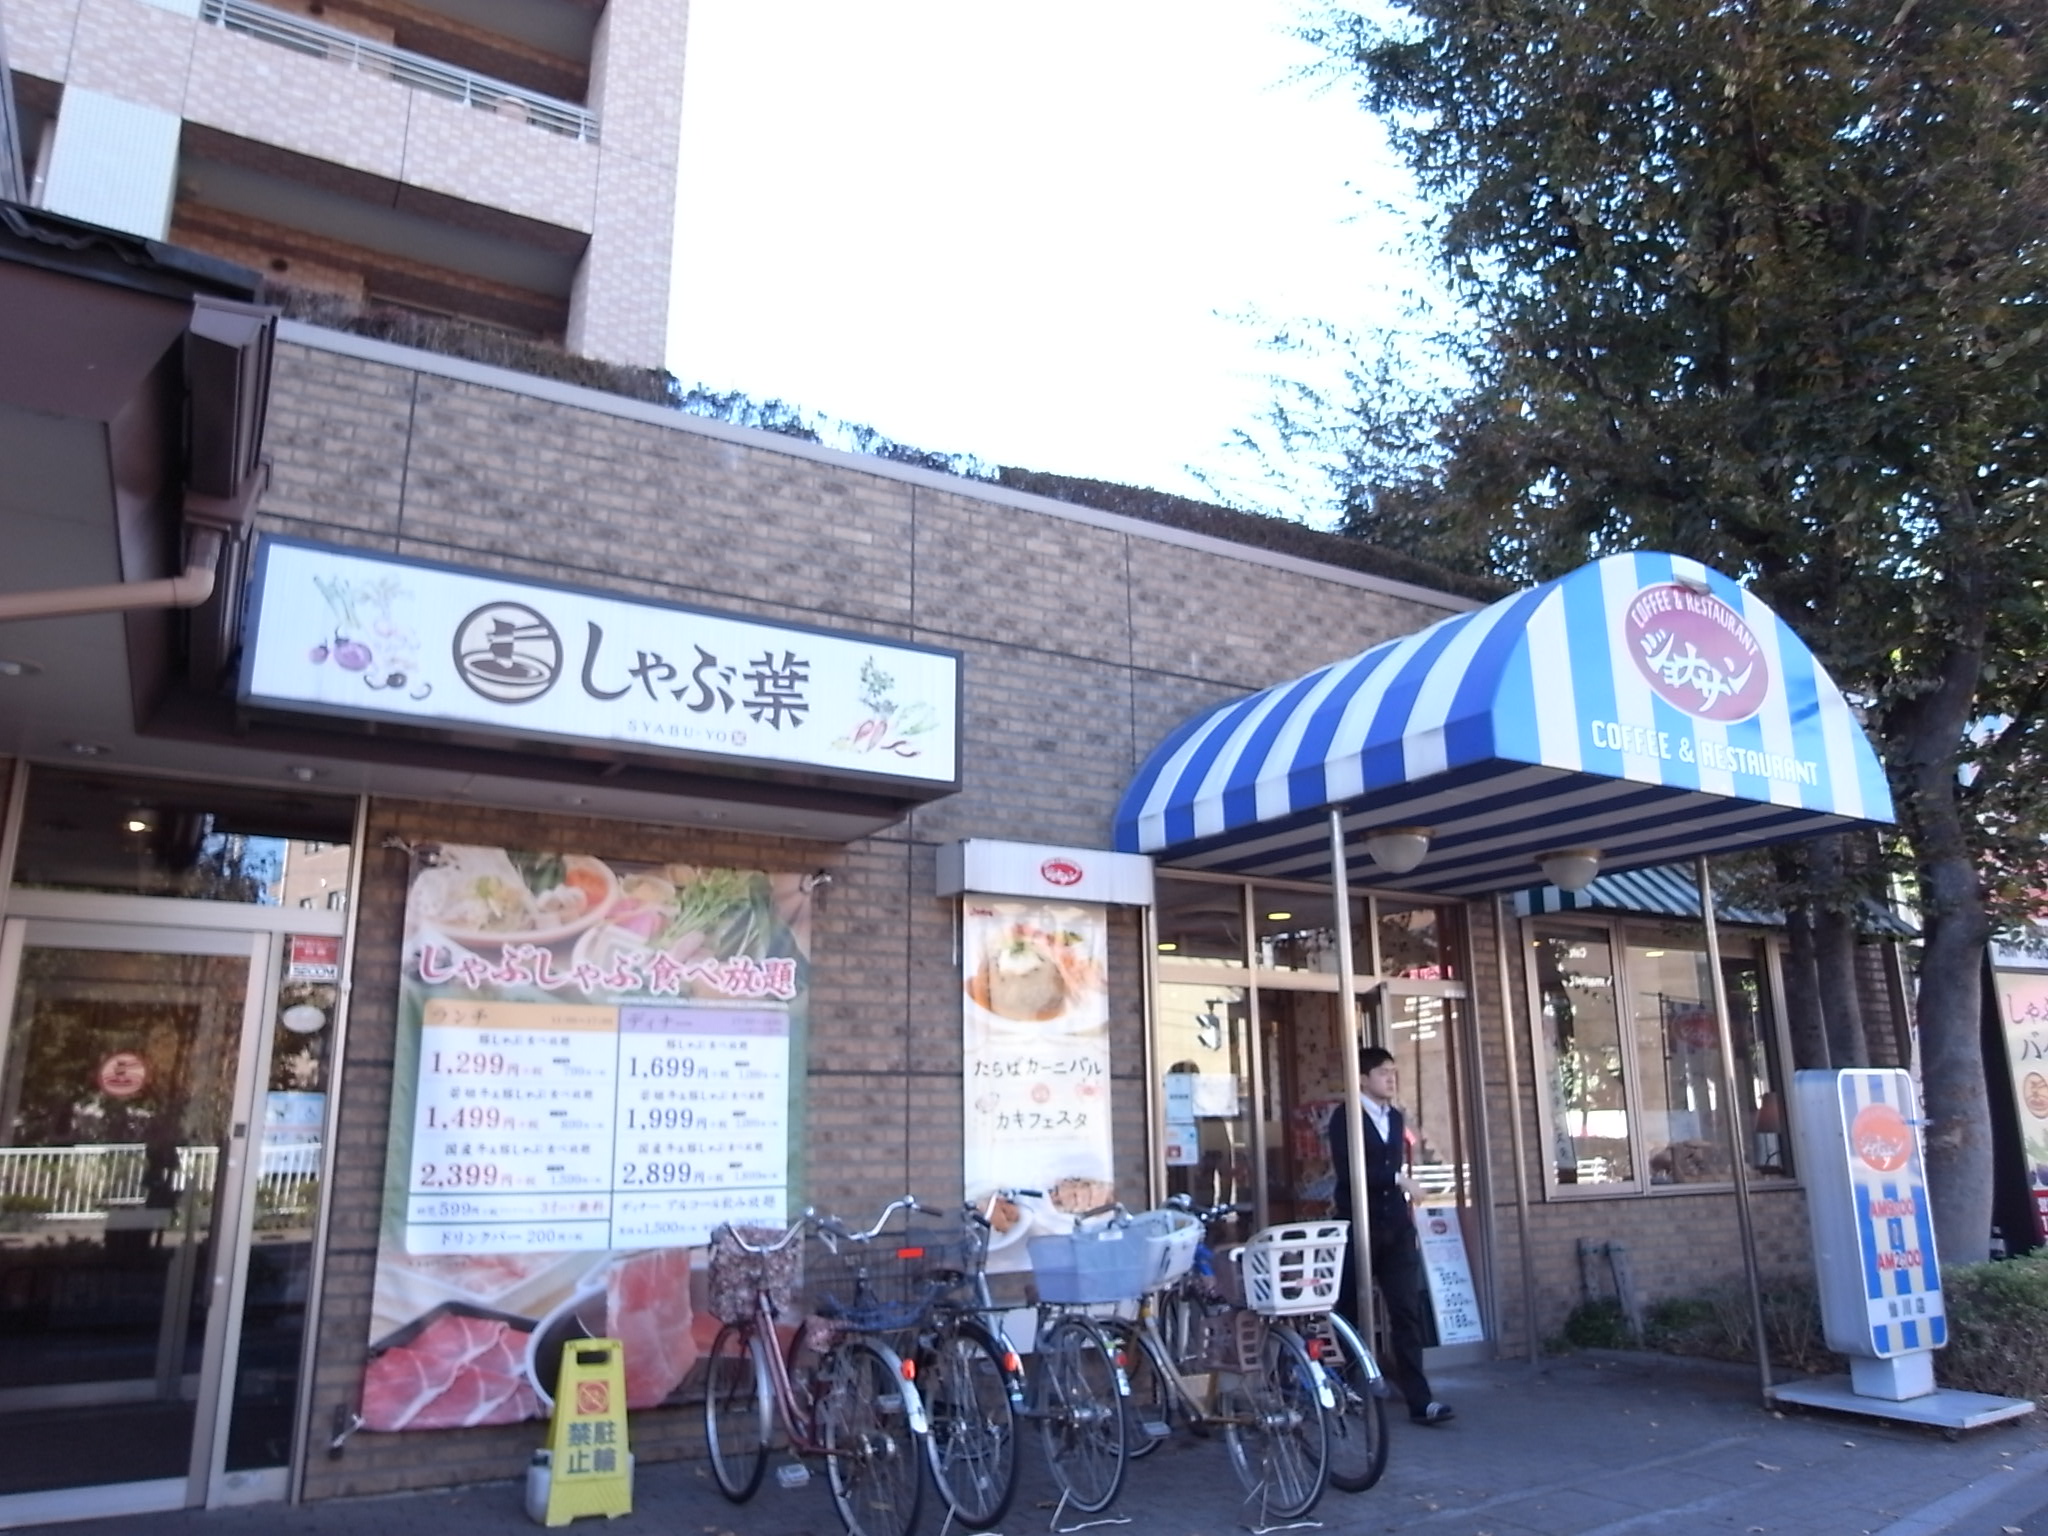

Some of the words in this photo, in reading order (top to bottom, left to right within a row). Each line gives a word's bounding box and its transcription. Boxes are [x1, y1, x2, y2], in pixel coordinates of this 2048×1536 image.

[1630, 590, 1670, 629] COFFEE
[1673, 590, 1682, 608] &
[1685, 592, 1759, 656] RESTAURANT
[581, 621, 811, 729] しゃぶ葉
[1591, 719, 1672, 760] COFFEE
[1678, 736, 1695, 764] &
[1700, 741, 1818, 786] RESTAURANT
[416, 943, 798, 998] しゃぶしゃぶ食べ放題
[975, 1056, 1103, 1078] たらばカーニバル
[996, 1109, 1087, 1129] カキフェスタ
